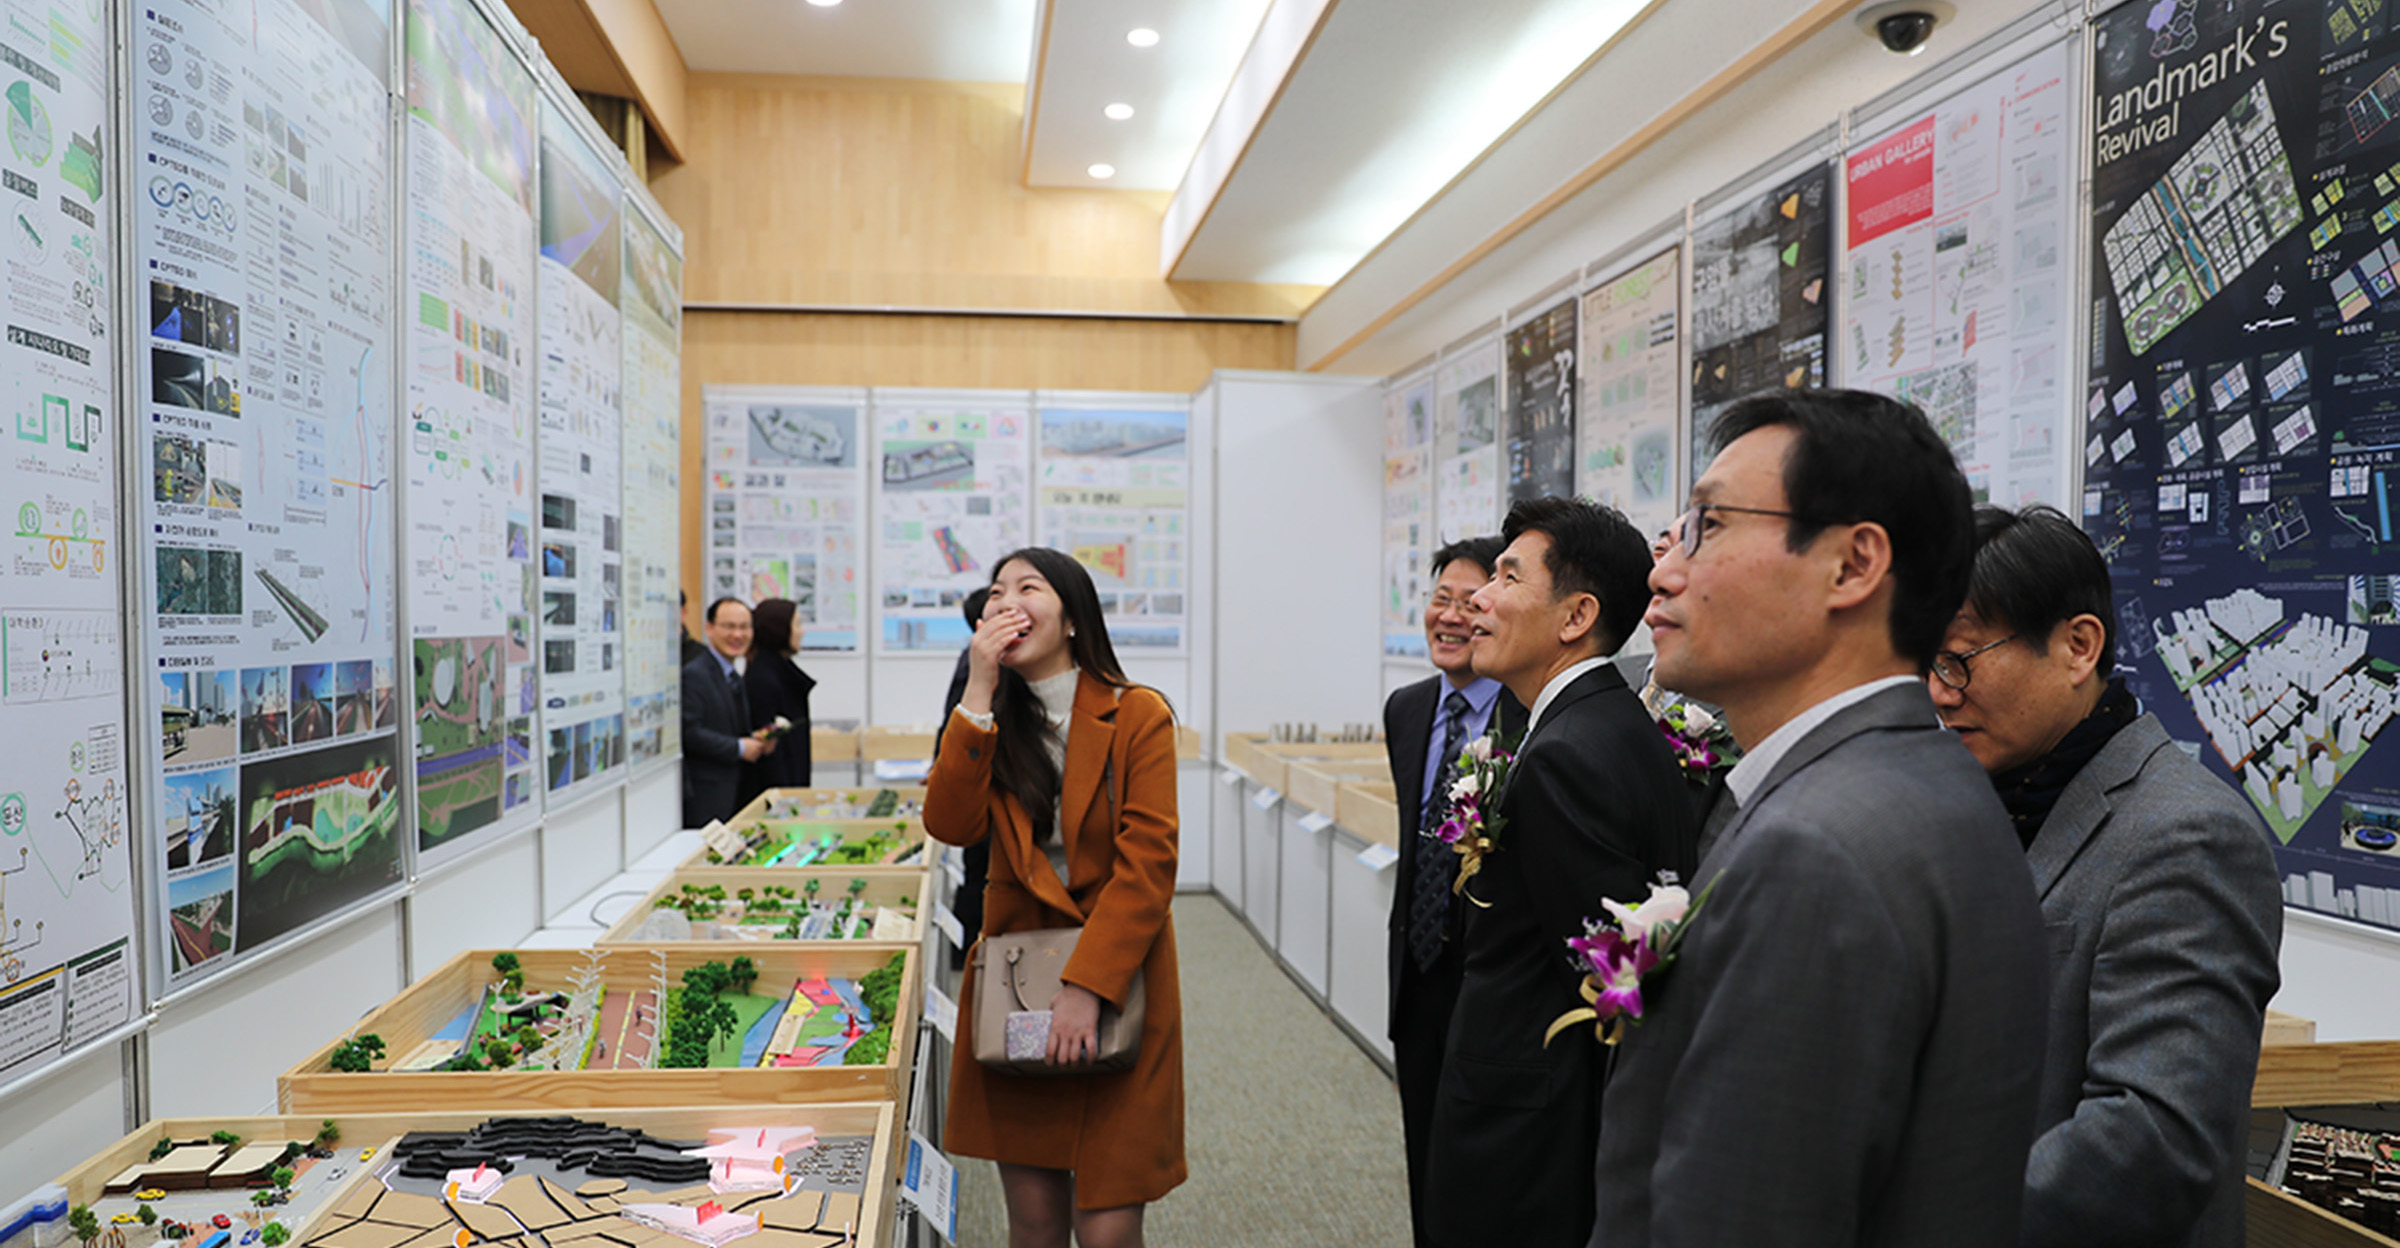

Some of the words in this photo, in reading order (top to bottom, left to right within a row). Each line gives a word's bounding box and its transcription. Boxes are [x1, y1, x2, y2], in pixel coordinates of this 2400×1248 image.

[2095, 16, 2289, 134] Landmark's
[1849, 153, 1883, 183] URBAN
[1885, 130, 1934, 165] GALLERY
[2096, 101, 2180, 167] Revival
